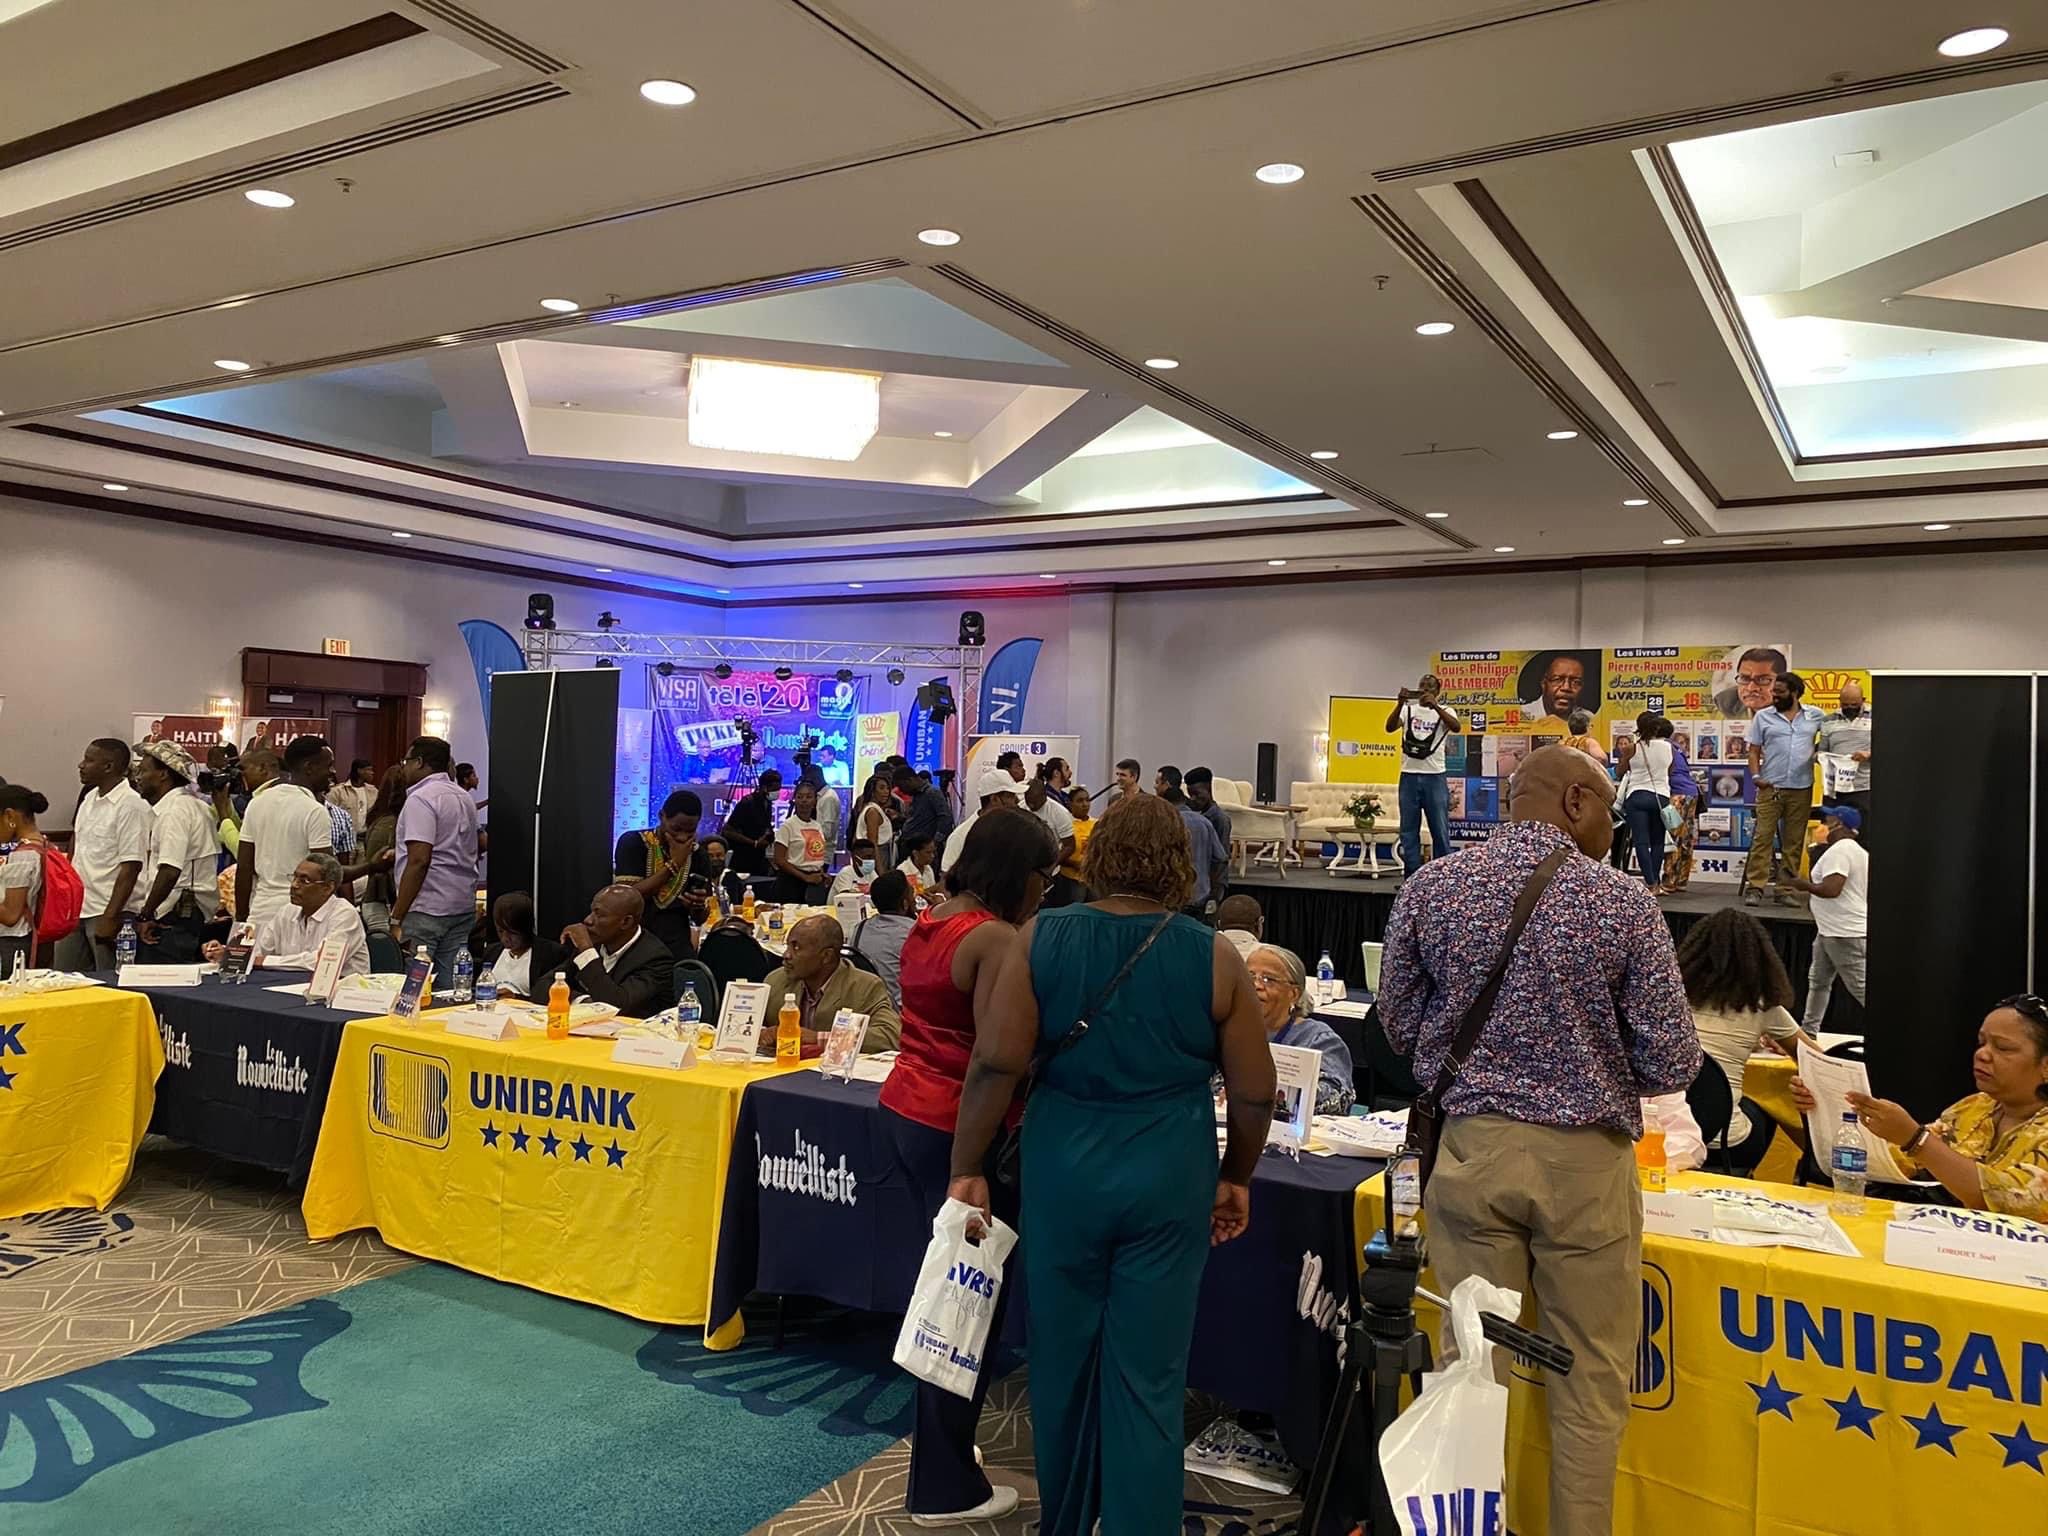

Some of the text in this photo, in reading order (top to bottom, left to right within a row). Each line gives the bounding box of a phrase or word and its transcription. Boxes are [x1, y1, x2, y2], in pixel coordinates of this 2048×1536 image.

[330, 639, 347, 655] EXIT
[1636, 649, 1661, 657] livres
[1608, 661, 1733, 674] Pierre-Raymond Dumas
[1649, 697, 1663, 706] 28
[1472, 713, 1485, 722] 28
[173, 730, 217, 743] HAITI
[1360, 743, 1396, 752] UNIBANK
[237, 1043, 309, 1095] Nouvelliste
[470, 1071, 636, 1132] UNIBANK
[755, 1130, 857, 1207] ouvelliste
